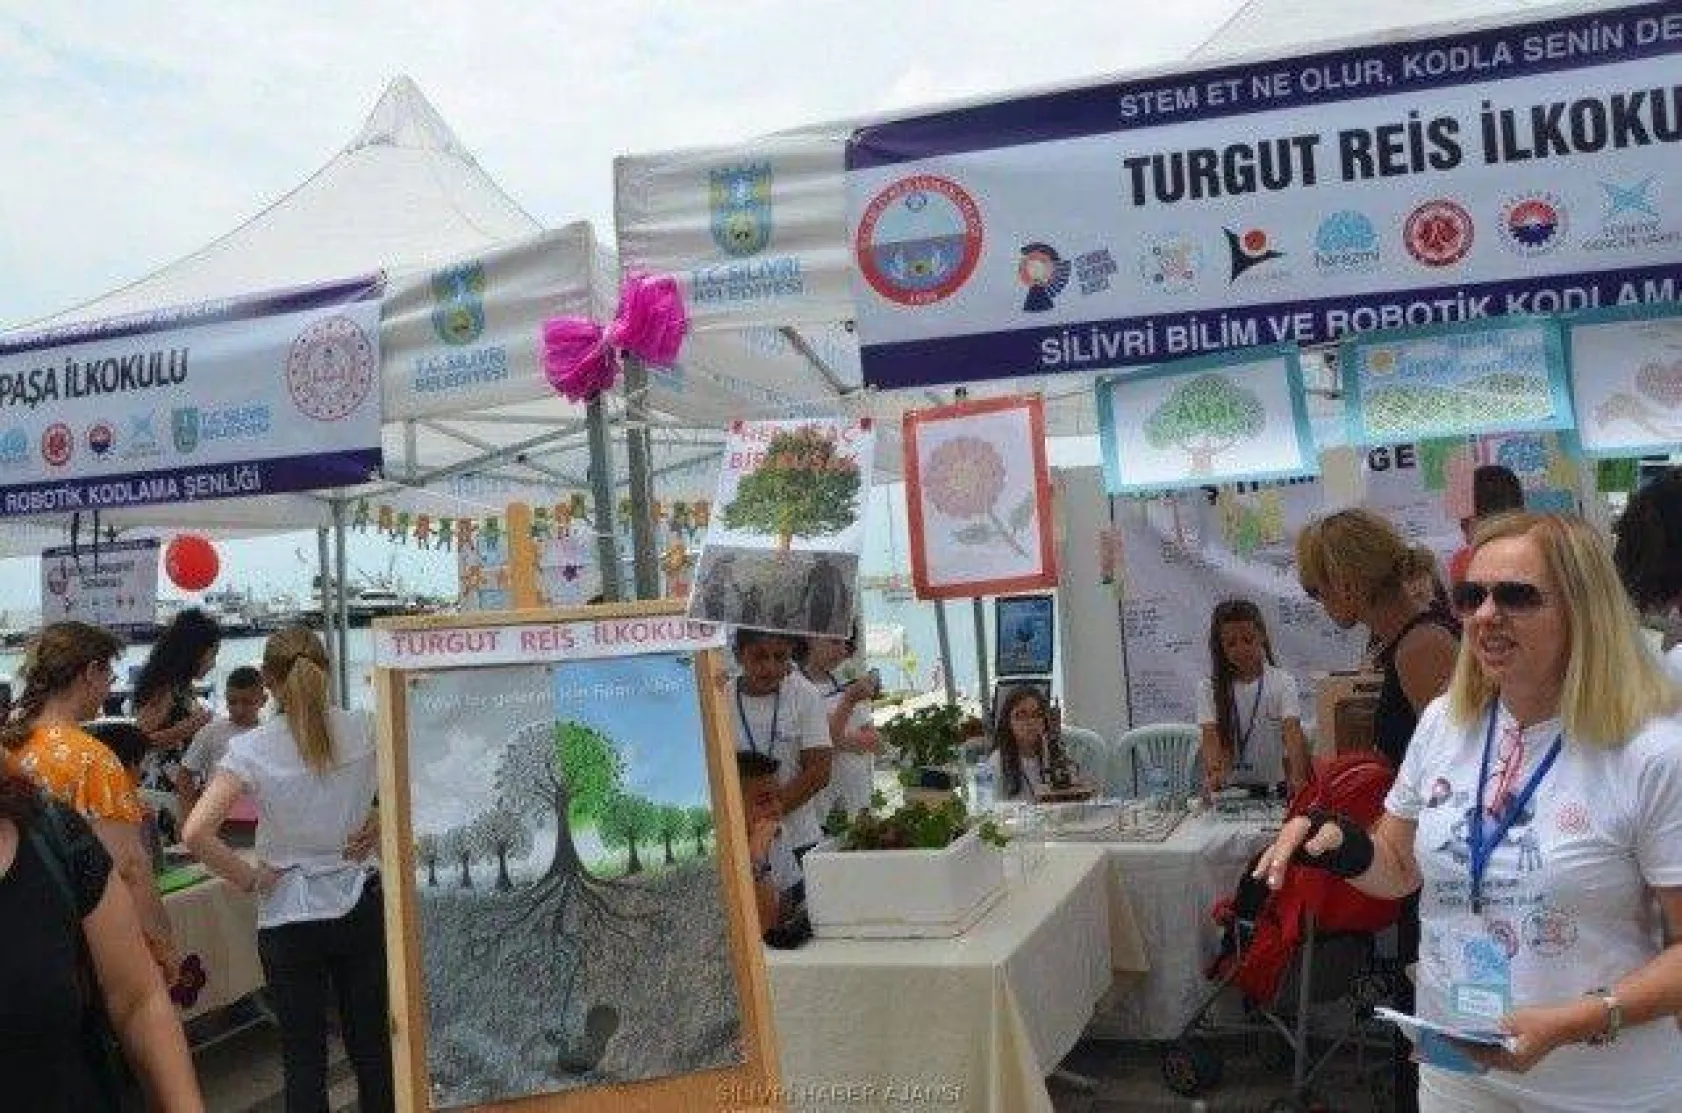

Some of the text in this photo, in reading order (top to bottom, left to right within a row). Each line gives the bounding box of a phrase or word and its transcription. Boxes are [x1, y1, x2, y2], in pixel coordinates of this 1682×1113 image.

[1120, 14, 1682, 117] STEM ET NE OLUR, KODLA SENİN DE
[1123, 84, 1682, 206] TURGUT REİS İLKOKU
[1040, 320, 1155, 365] SİLİVRİ
[1166, 312, 1258, 354] BİLİM
[1268, 311, 1315, 343] VE
[1327, 291, 1492, 342] ROBOTİK
[1505, 277, 1682, 318] KODLAM
[0, 347, 190, 410] PAŞA İLKOKULU
[5, 464, 263, 518] ROBOTİK KODLAMA ŞENLİĞİ
[392, 630, 500, 657] TURGUT
[520, 623, 576, 653] REİS
